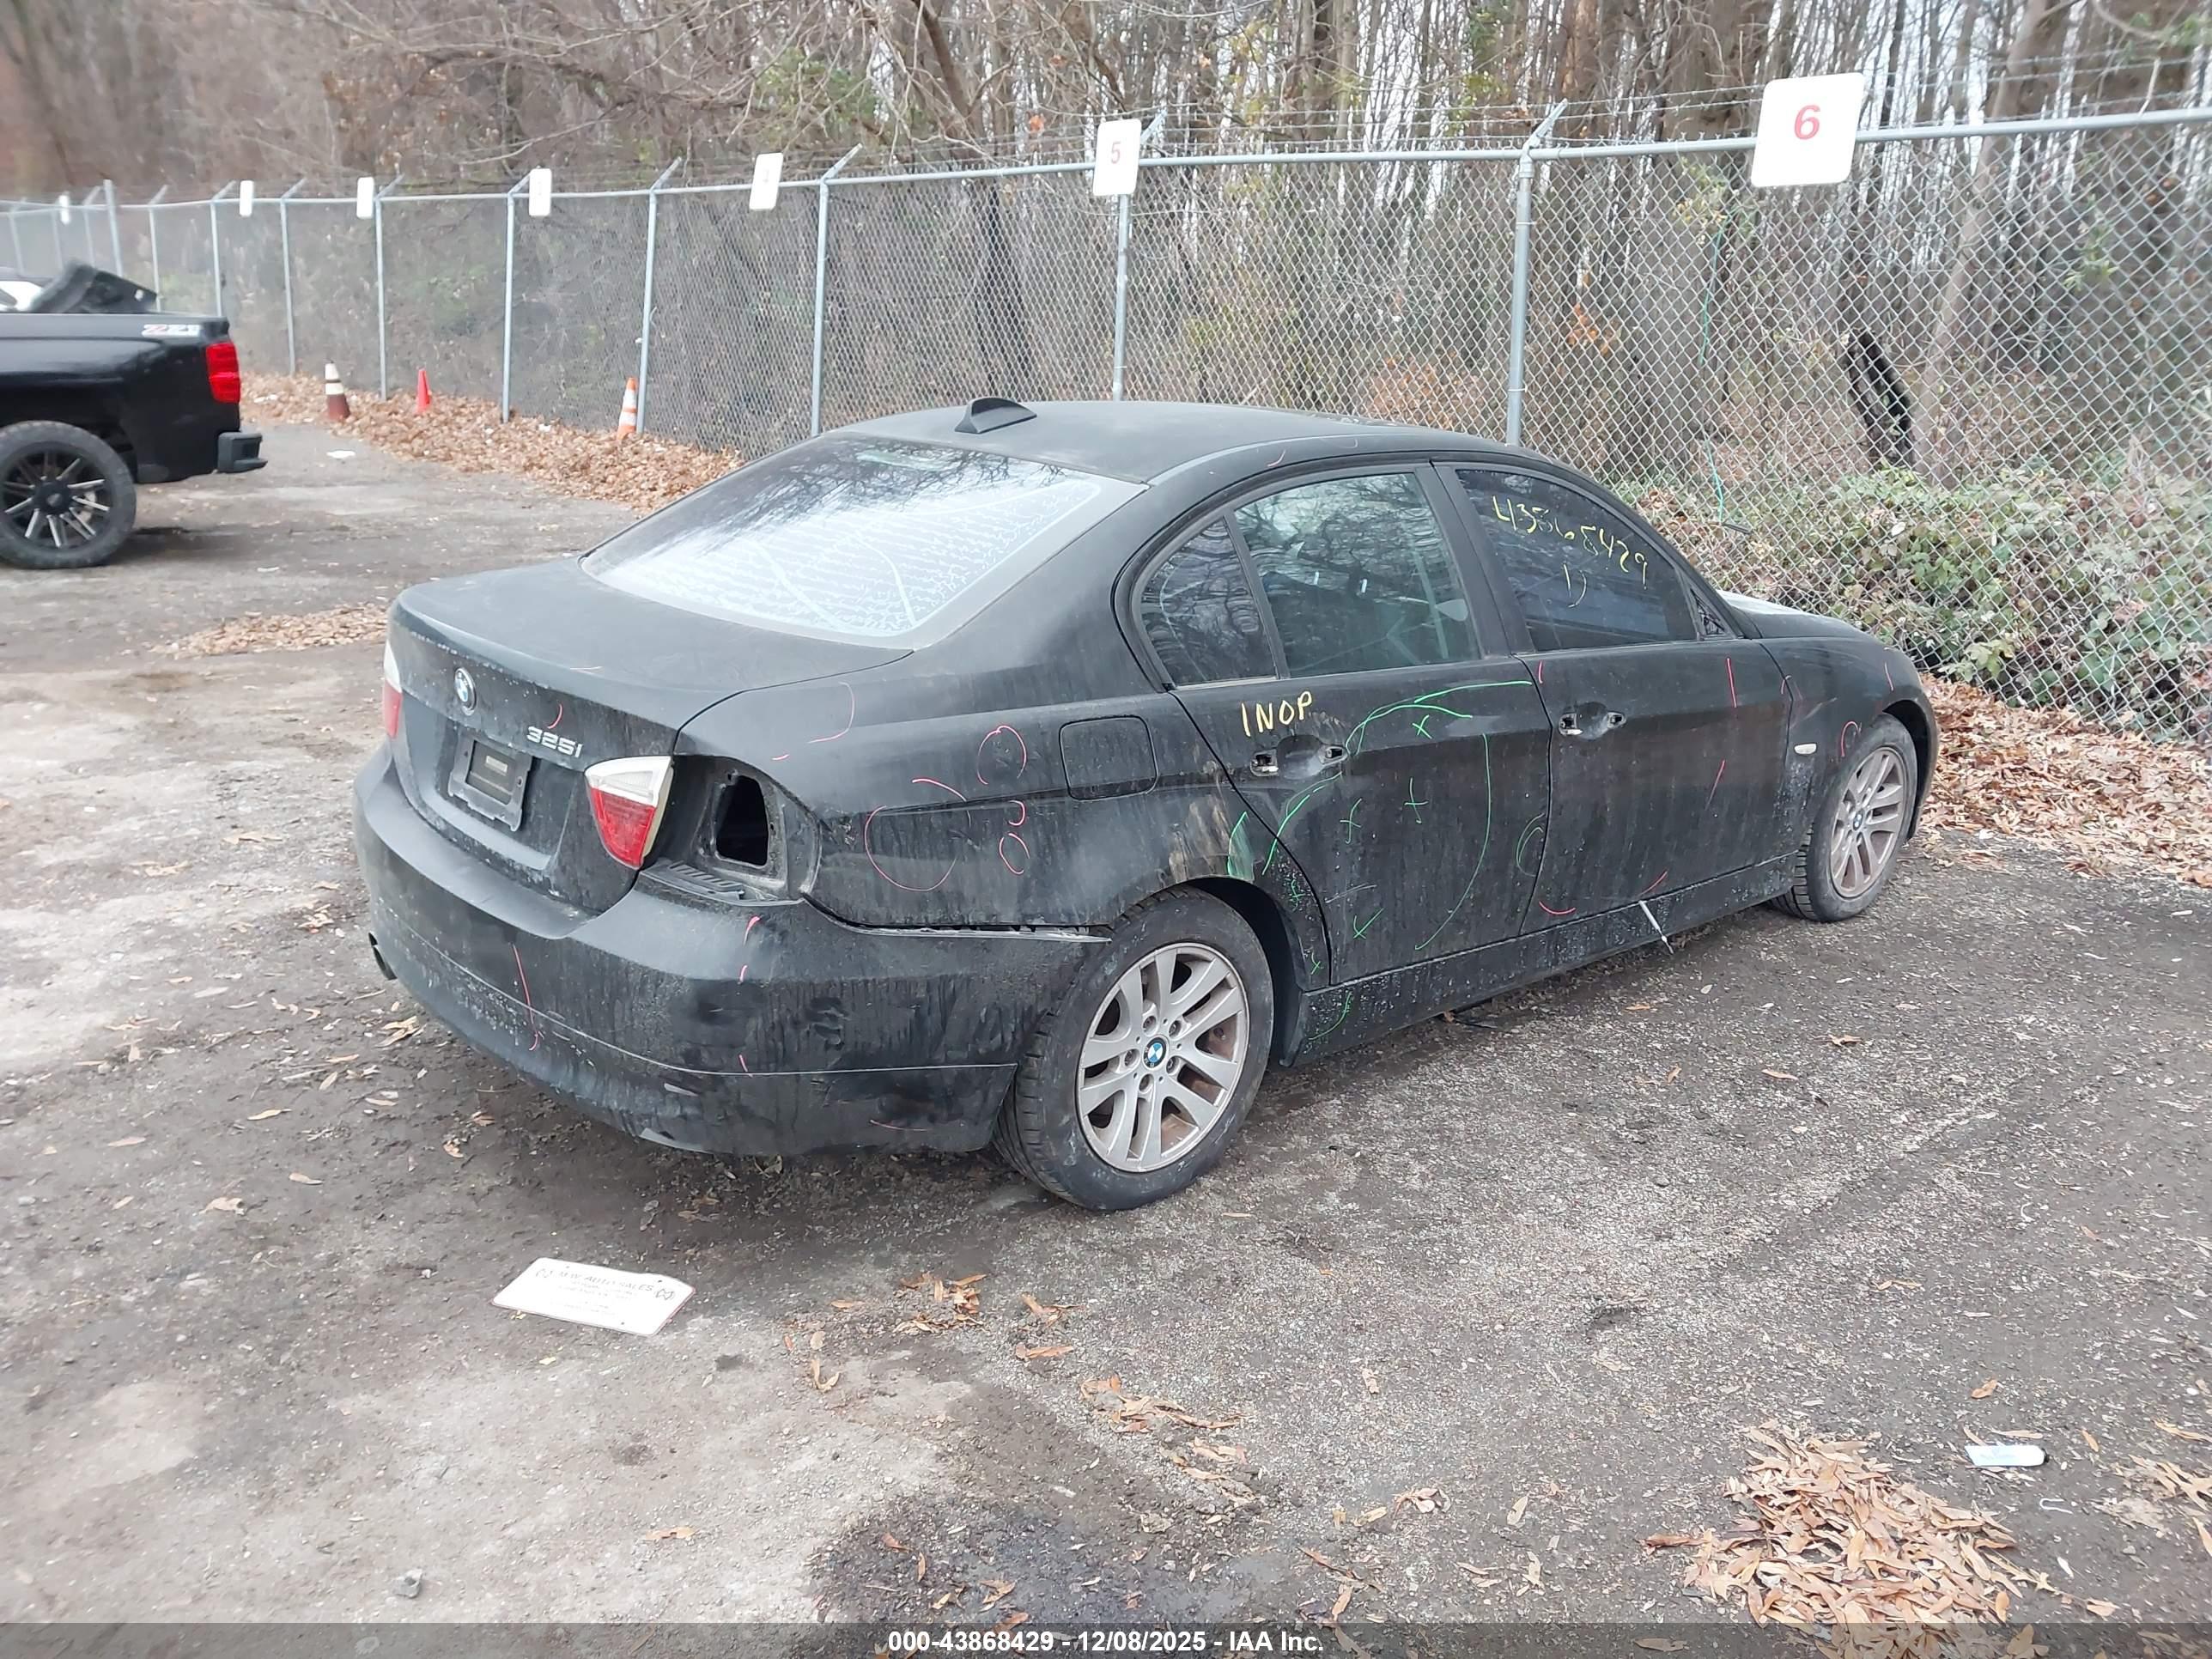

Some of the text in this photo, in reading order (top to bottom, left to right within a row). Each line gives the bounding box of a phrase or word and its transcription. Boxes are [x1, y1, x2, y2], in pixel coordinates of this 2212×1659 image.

[1794, 104, 1821, 140] 6
[1111, 141, 1121, 164] 5
[1241, 690, 1313, 738] INOP
